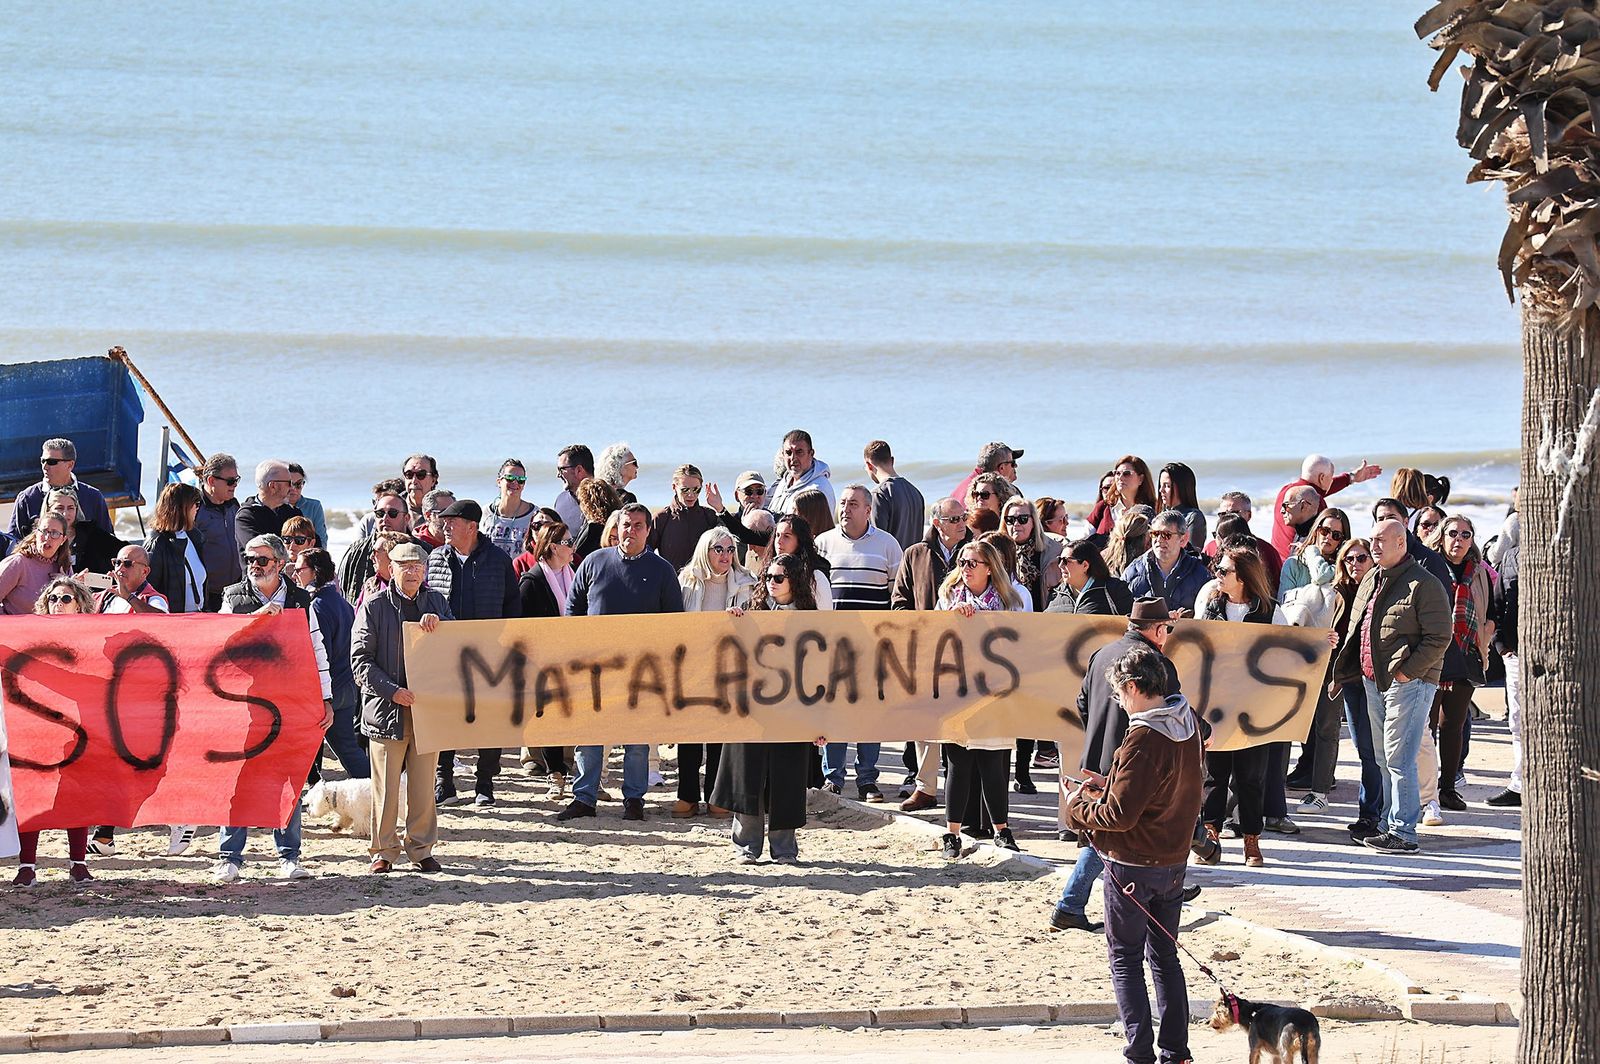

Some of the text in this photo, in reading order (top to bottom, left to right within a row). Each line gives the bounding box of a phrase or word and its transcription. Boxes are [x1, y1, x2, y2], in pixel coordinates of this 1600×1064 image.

[1, 637, 282, 771] SOS
[459, 619, 1318, 737] MATALASCAÑAS SO.S
